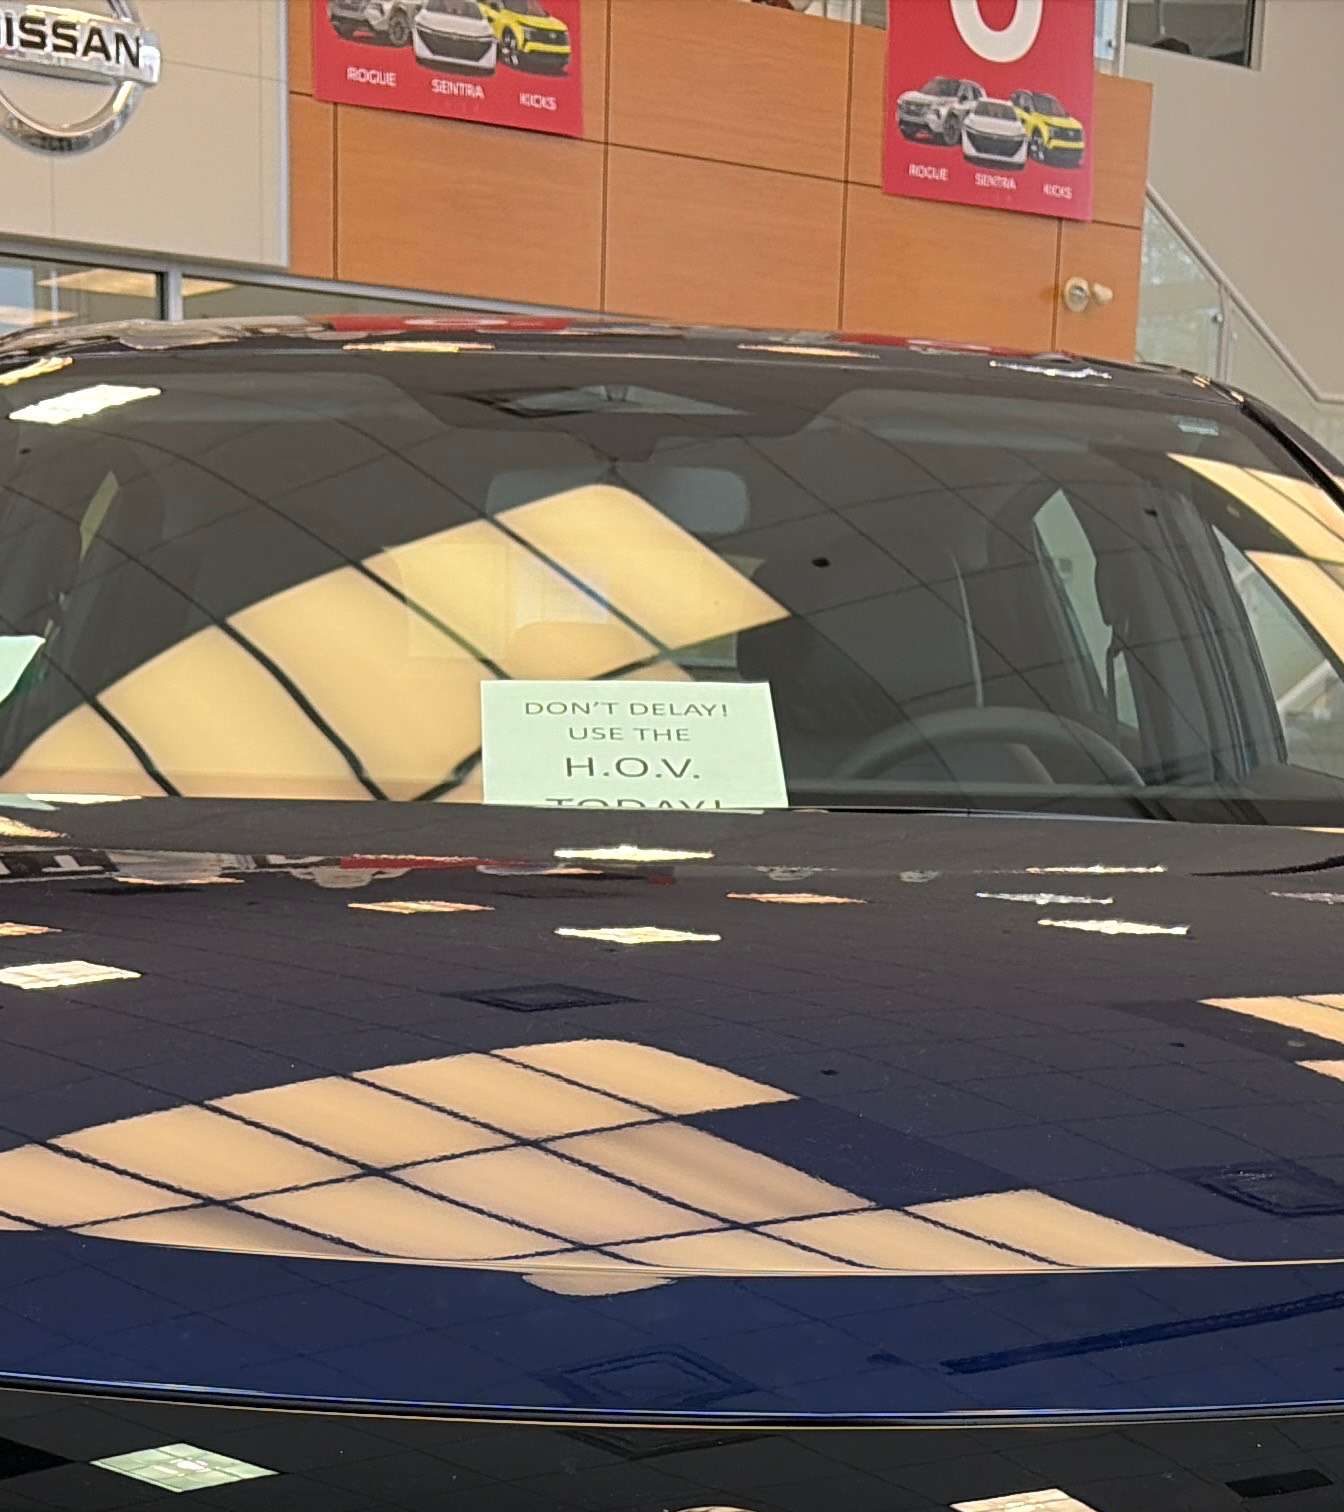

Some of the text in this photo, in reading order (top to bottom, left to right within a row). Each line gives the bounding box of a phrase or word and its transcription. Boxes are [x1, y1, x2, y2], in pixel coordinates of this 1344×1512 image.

[431, 79, 485, 99] SENTRA
[525, 701, 728, 717] DON'T DELAY!
[569, 727, 690, 742] USE THE
[566, 756, 700, 779] H.O.V.
